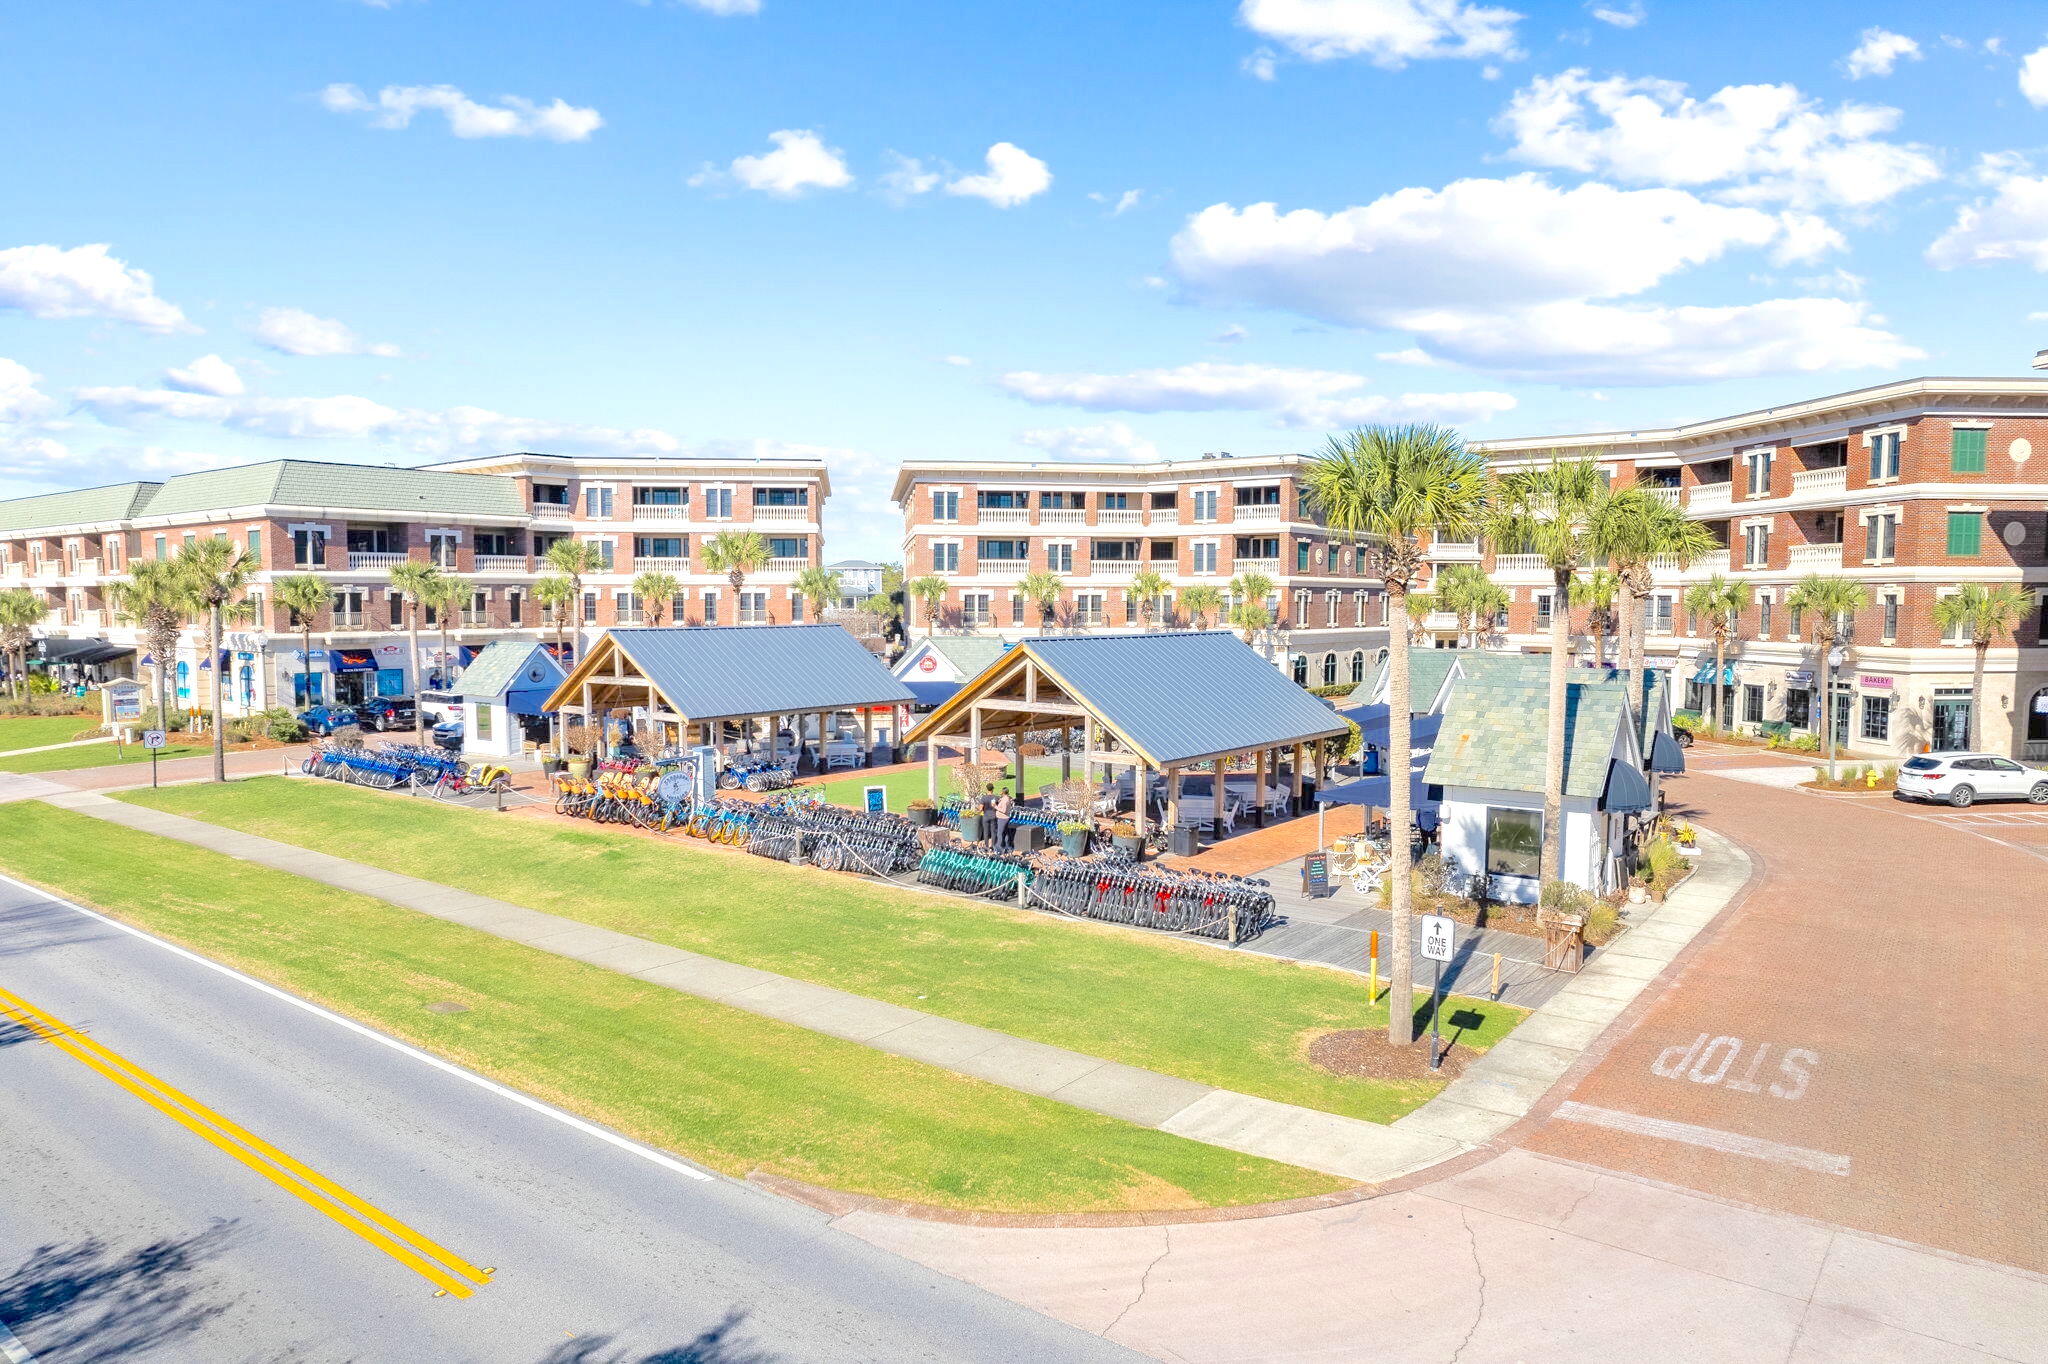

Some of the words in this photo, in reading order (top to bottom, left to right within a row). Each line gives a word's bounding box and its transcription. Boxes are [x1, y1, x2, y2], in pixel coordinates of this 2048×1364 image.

[1864, 675, 1889, 684] BAKERY
[1427, 935, 1447, 948] ONE
[1427, 944, 1447, 957] WAY
[1650, 1032, 1820, 1101] STOP
